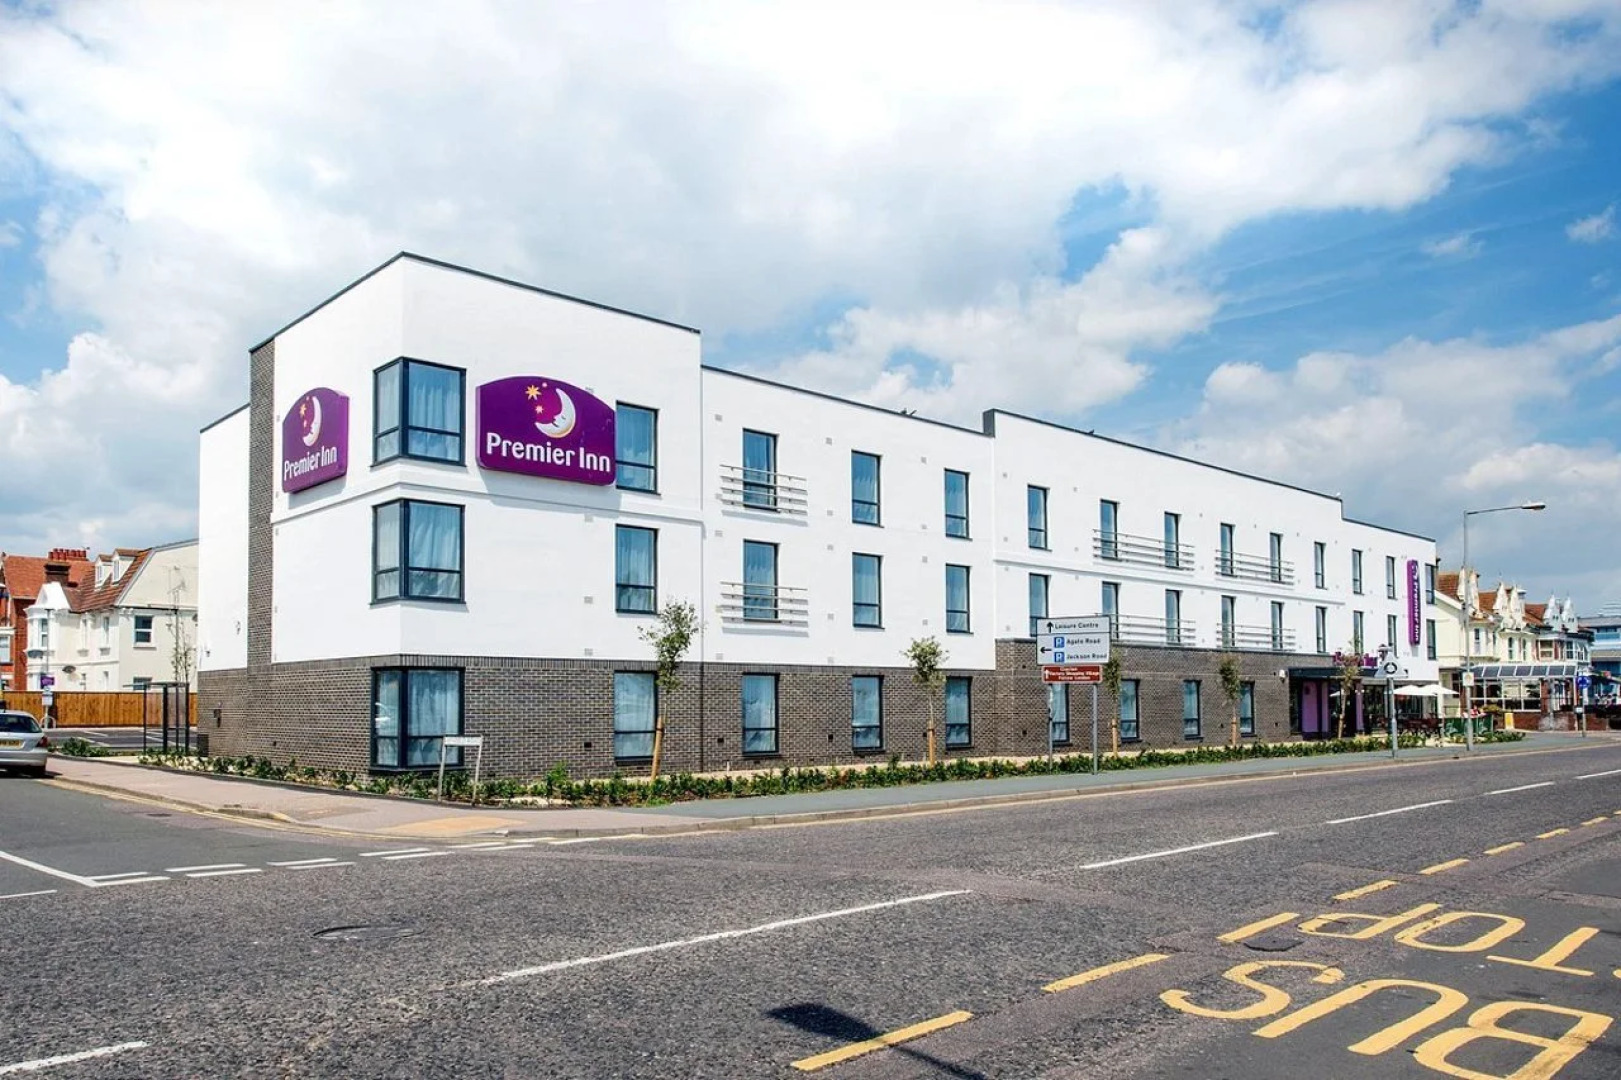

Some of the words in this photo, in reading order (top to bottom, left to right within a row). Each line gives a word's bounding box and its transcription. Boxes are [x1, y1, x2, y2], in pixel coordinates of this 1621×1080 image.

[283, 451, 321, 482] Premier
[321, 445, 338, 466] Inn
[486, 432, 576, 467] Premier
[579, 446, 612, 472] Inn
[1298, 903, 1621, 981] TOP
[1160, 960, 1614, 1080] BUS
